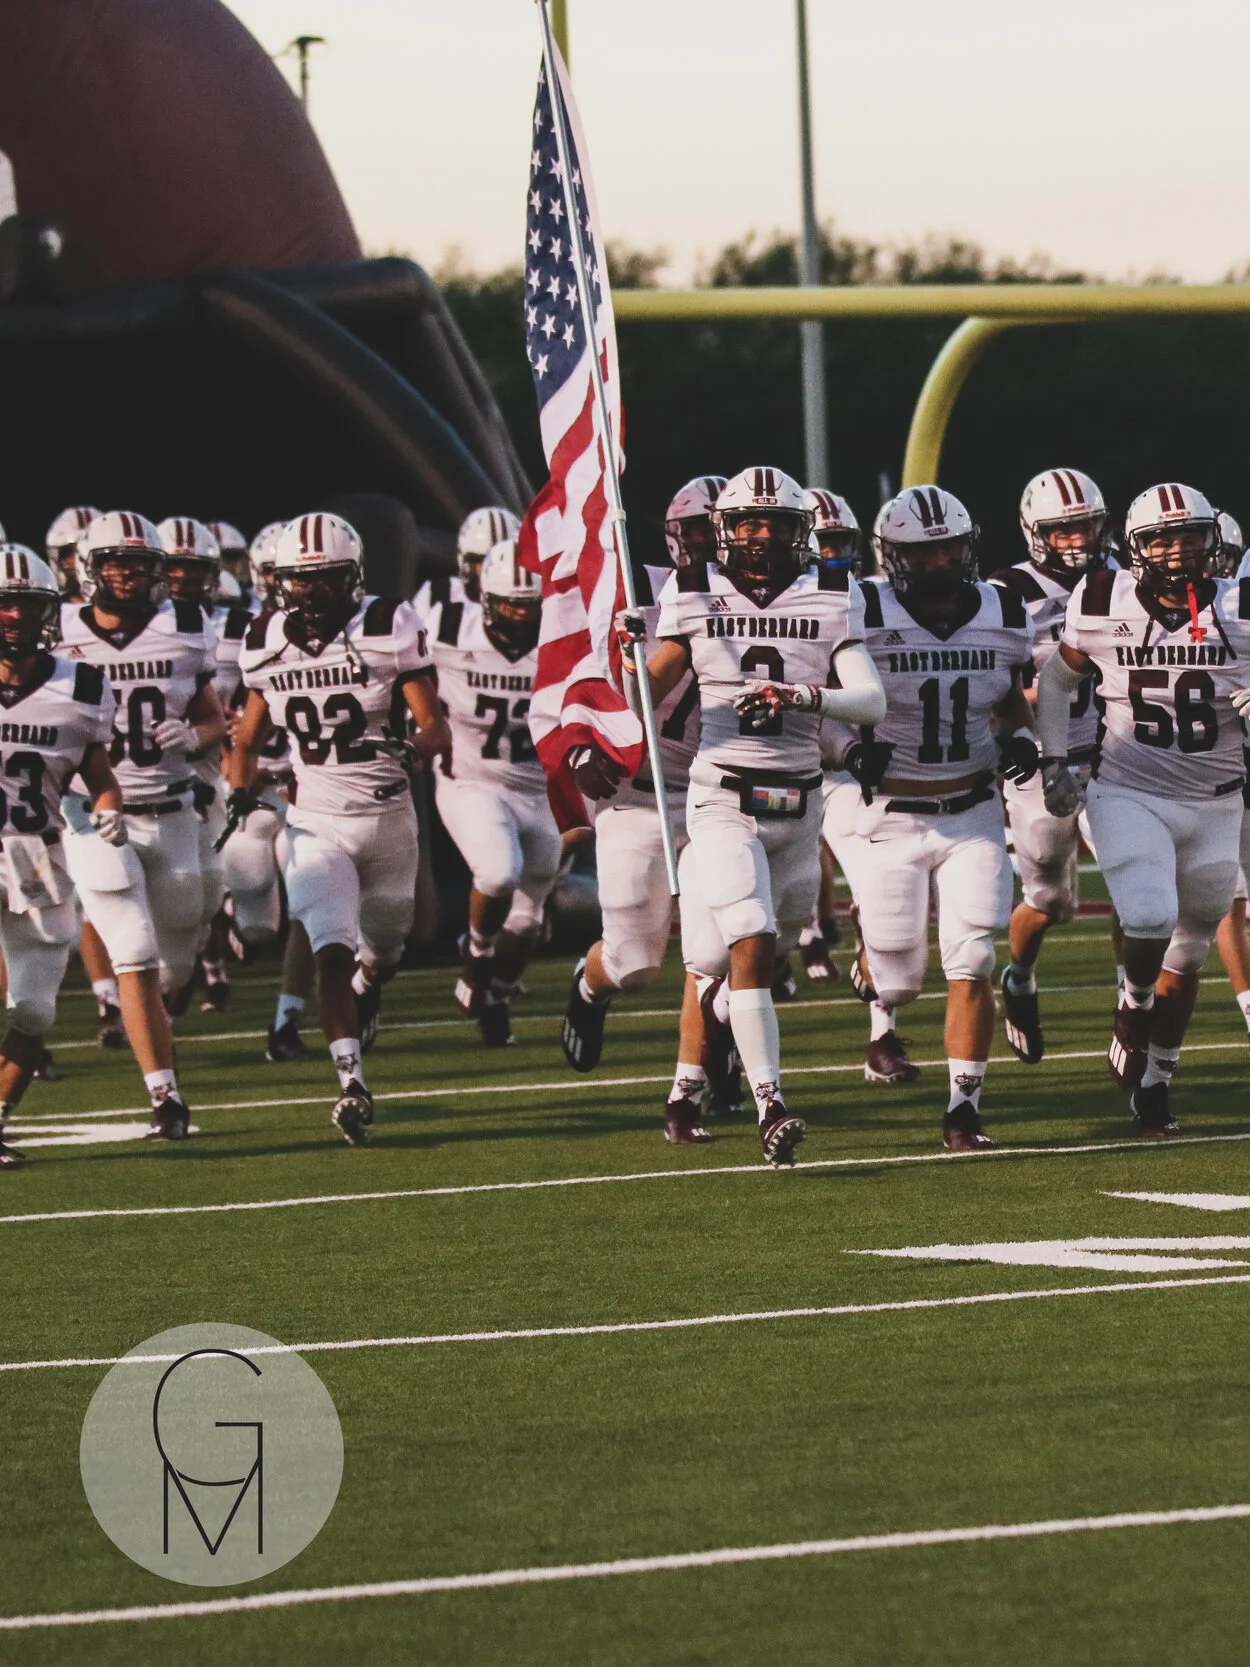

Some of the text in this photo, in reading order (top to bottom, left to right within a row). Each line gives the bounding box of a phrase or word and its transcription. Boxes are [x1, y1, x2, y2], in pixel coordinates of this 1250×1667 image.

[706, 617, 820, 640] EAST BERNARD
[887, 649, 996, 673] EAST BERNARD
[1116, 646, 1227, 668] EAST BERNARD
[109, 659, 173, 682] BERNARD
[466, 671, 533, 692] EAST BERN
[285, 692, 377, 766] 82
[917, 676, 971, 764] 11
